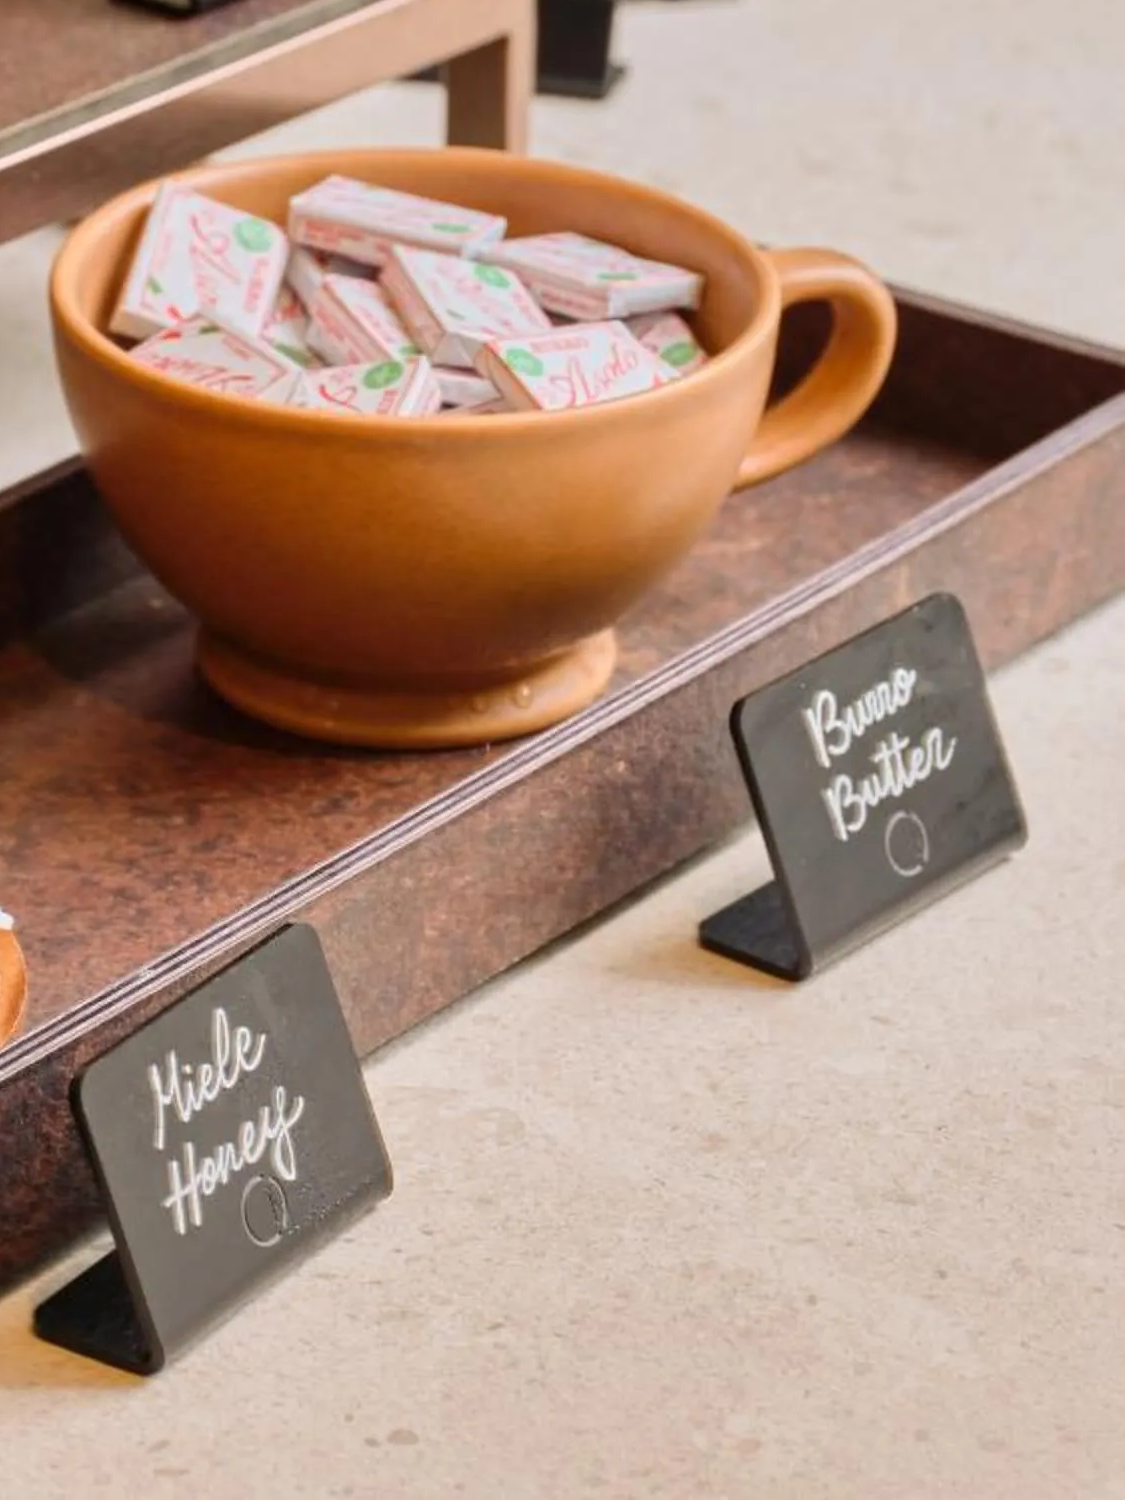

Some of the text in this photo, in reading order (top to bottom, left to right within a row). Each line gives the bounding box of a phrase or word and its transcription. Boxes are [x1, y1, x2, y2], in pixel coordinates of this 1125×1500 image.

[802, 666, 917, 768] Burro
[821, 727, 958, 842] Butter
[147, 1007, 266, 1150] Miele
[162, 1085, 304, 1236] Honey
